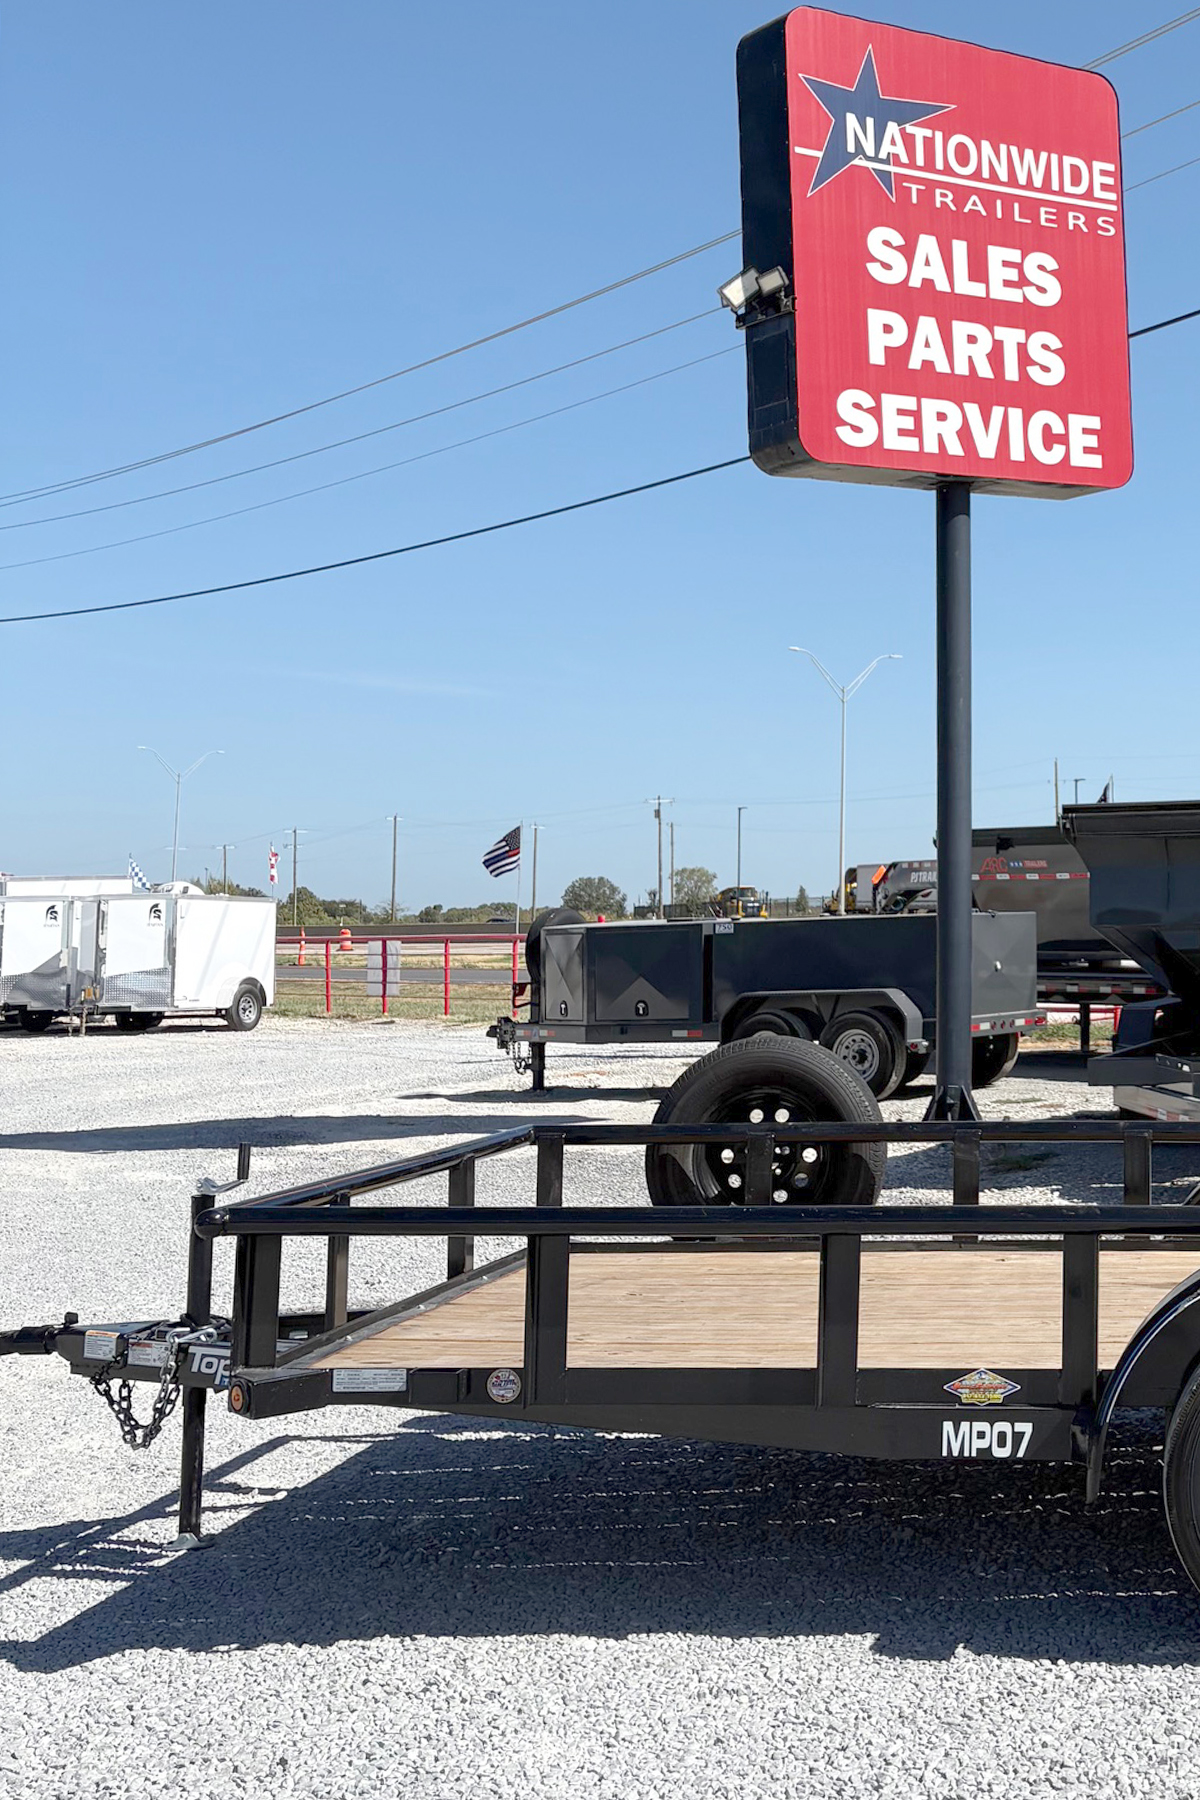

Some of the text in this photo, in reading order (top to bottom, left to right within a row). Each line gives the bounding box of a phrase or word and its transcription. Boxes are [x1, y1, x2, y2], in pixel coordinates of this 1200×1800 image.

[845, 112, 1117, 201] NATIONWIDE
[902, 182, 1117, 237] TRAILERS
[866, 226, 1062, 308] SALES
[867, 308, 1066, 387] PARTS
[835, 389, 1103, 469] SERVICE
[981, 857, 1008, 872] ARC
